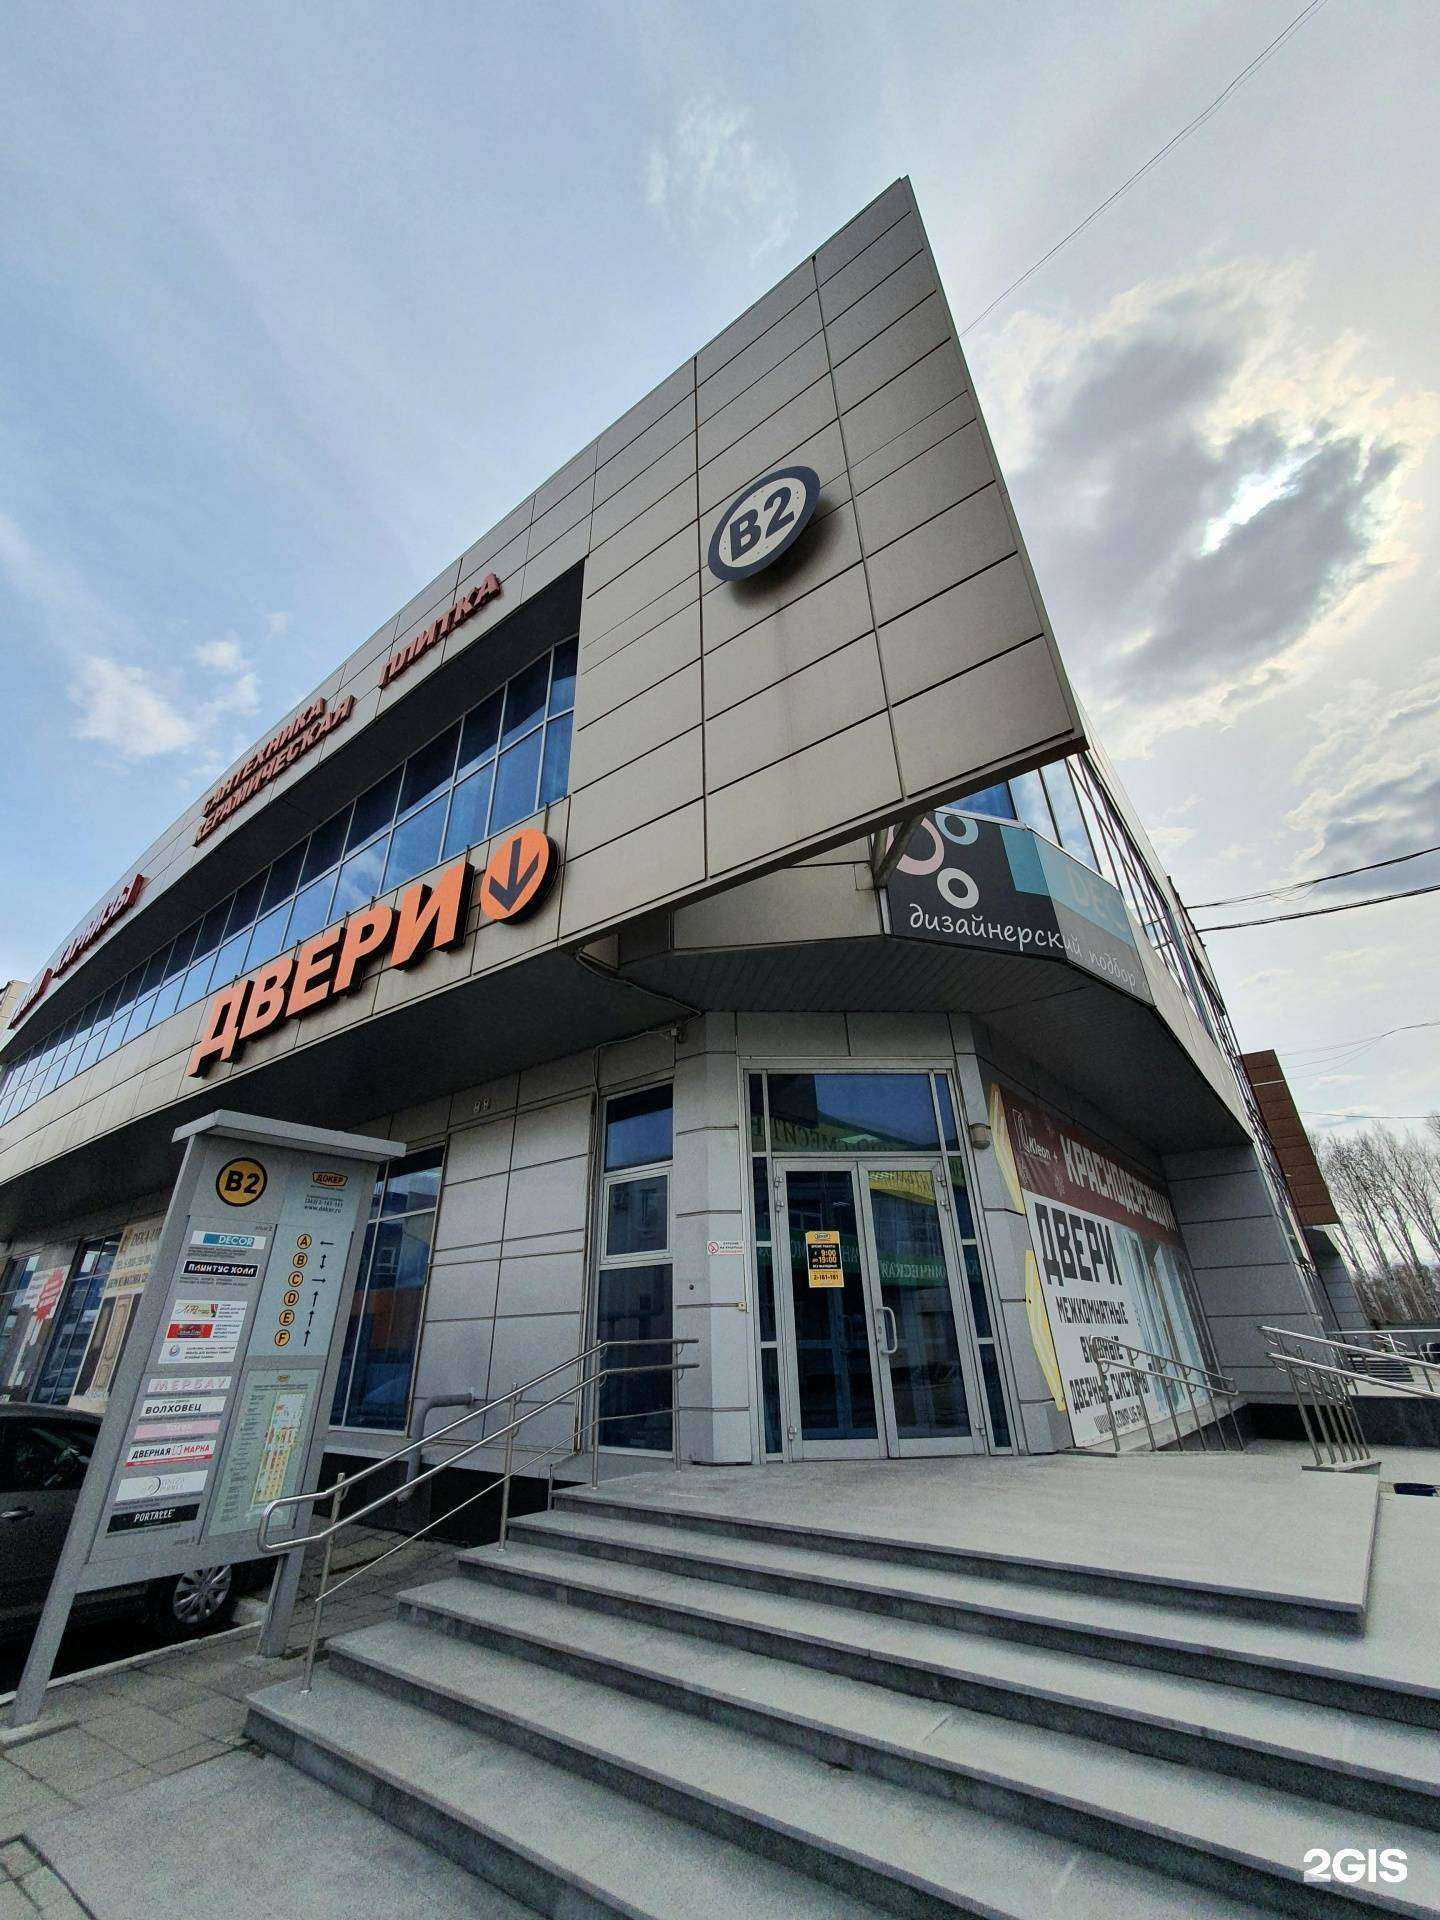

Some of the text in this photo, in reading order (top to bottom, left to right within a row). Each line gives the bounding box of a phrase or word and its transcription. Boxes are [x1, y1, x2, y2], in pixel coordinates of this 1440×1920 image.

[729, 487, 795, 562] B2
[379, 572, 503, 690] ПЛИТКА
[909, 902, 1137, 992] дизайнерский подбор
[186, 861, 470, 1078] ДВЕРИ
[224, 1170, 260, 1194] B2
[218, 1235, 254, 1247] DECOR
[1034, 1202, 1122, 1287] ДВЕРИ
[188, 1263, 230, 1273] ПЛИНТУС
[1055, 1296, 1129, 1324] МЕЖКОМНАТНЫЕ
[1110, 1370, 1151, 1400] СИСТЫ
[145, 1403, 202, 1415] ВОЛХОВЕЦ
[132, 1447, 171, 1460] ДВЕРНАЯ
[184, 1444, 210, 1454] МАРКА
